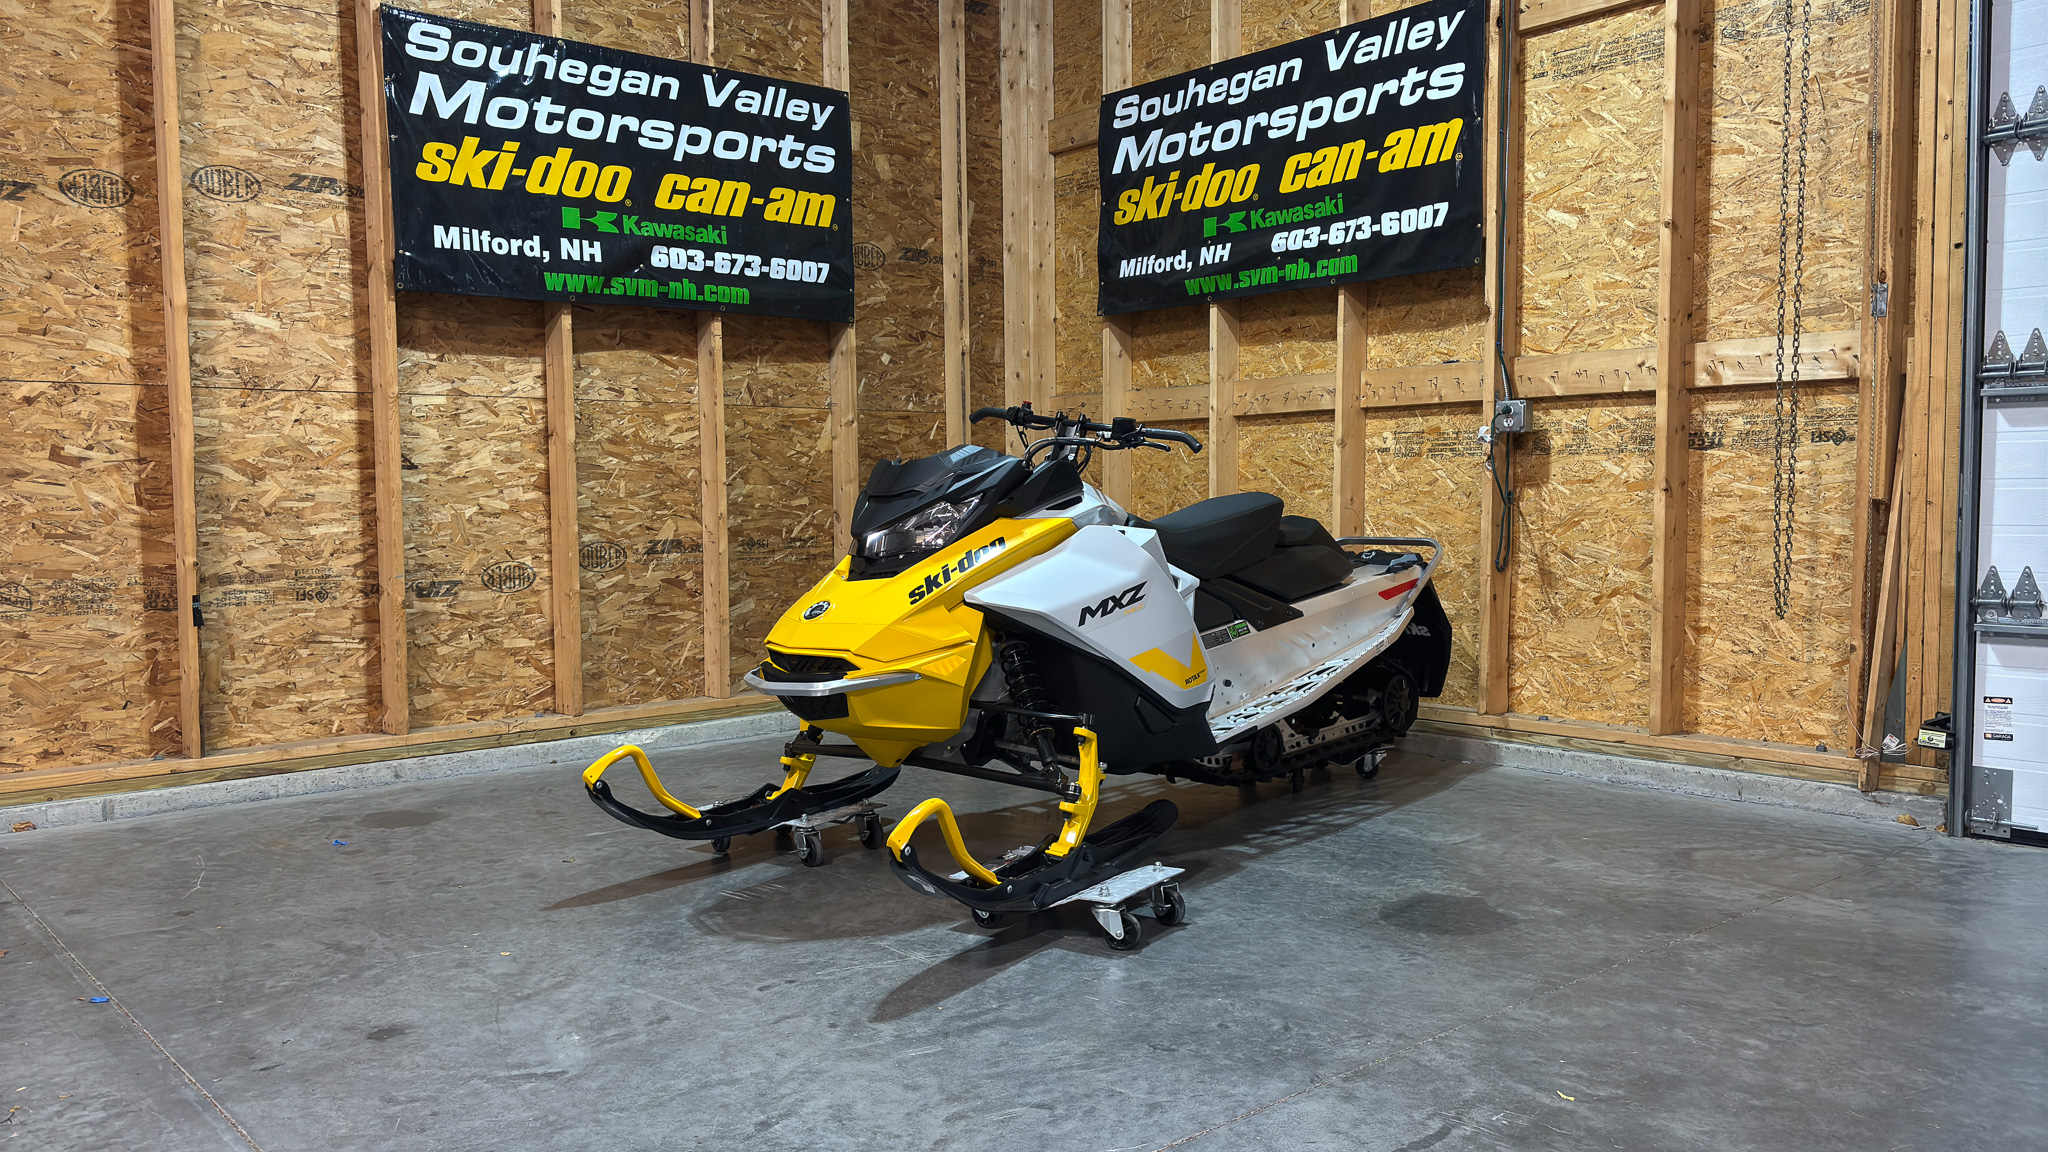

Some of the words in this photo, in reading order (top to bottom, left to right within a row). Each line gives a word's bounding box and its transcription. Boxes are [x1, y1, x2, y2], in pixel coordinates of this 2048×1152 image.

[404, 20, 680, 99] Souhegan
[702, 73, 835, 131] Valley
[1112, 57, 1303, 129] Souhegan
[1324, 9, 1466, 72] Valley
[408, 71, 837, 174] Motorsports
[1111, 62, 1466, 175] Motorsports
[415, 136, 632, 203] ski-doo
[654, 173, 837, 228] can-am
[1114, 163, 1261, 226] ski-doo
[1279, 118, 1464, 194] can-am
[623, 214, 727, 245] Kawasaki
[1118, 249, 1193, 278] Milford,
[1200, 243, 1232, 267] NH
[1270, 202, 1449, 253] 603-673-6007
[1250, 193, 1344, 231] Kawasaki
[433, 225, 551, 263] Milford,
[560, 238, 603, 263] NH
[650, 245, 830, 284] 603-673-6007
[544, 271, 750, 305] www.svm-nh.com
[1184, 253, 1358, 296] www.svm-nh.com
[1078, 580, 1148, 628] MXZ
